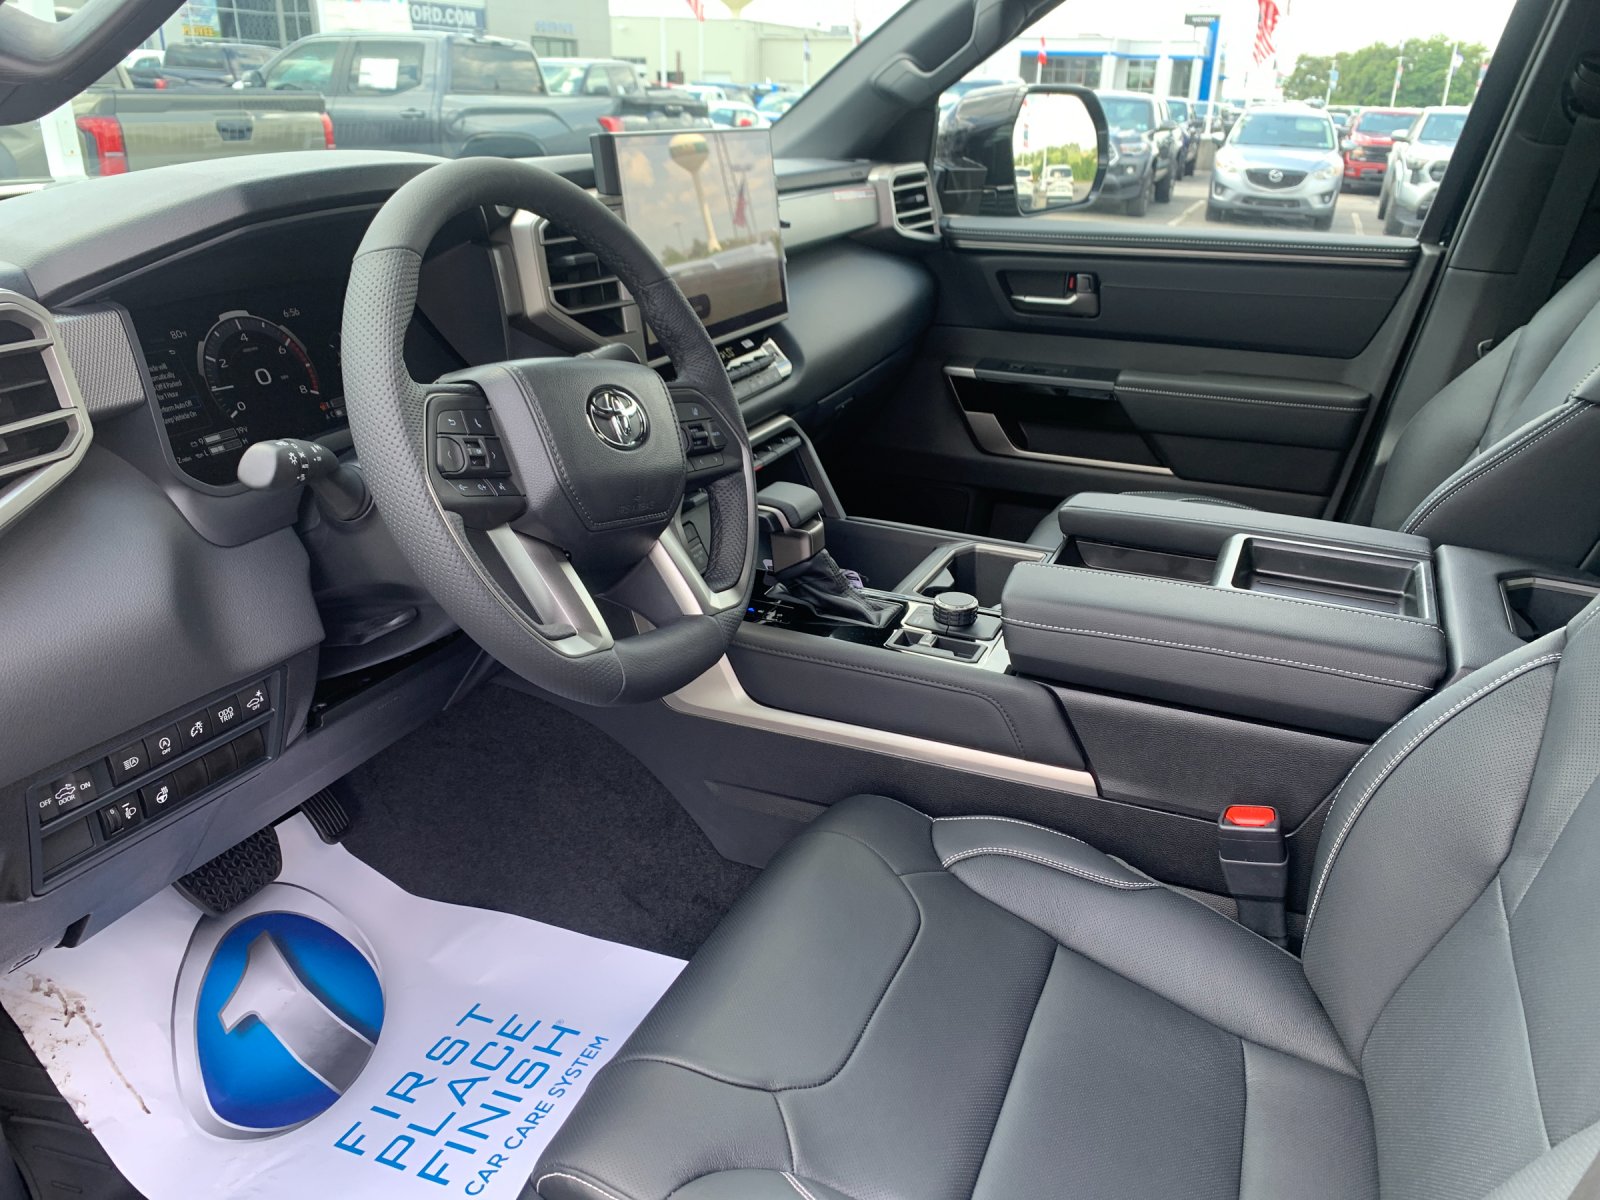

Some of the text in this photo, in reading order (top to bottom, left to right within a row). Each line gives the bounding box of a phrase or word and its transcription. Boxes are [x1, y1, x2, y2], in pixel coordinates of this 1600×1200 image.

[240, 333, 249, 342] 4
[278, 345, 287, 355] 6
[219, 358, 229, 368] 2
[254, 368, 272, 386] 0
[299, 385, 308, 395] 8
[236, 401, 247, 412] 0
[80, 781, 91, 790] ON
[39, 798, 52, 808] OFF
[58, 794, 76, 806] DOOR
[334, 1002, 494, 1157] FIRST
[374, 1012, 541, 1172] PLACE
[416, 1023, 582, 1187] FINISH
[464, 1035, 610, 1197] CAR CARE SYSTEM
